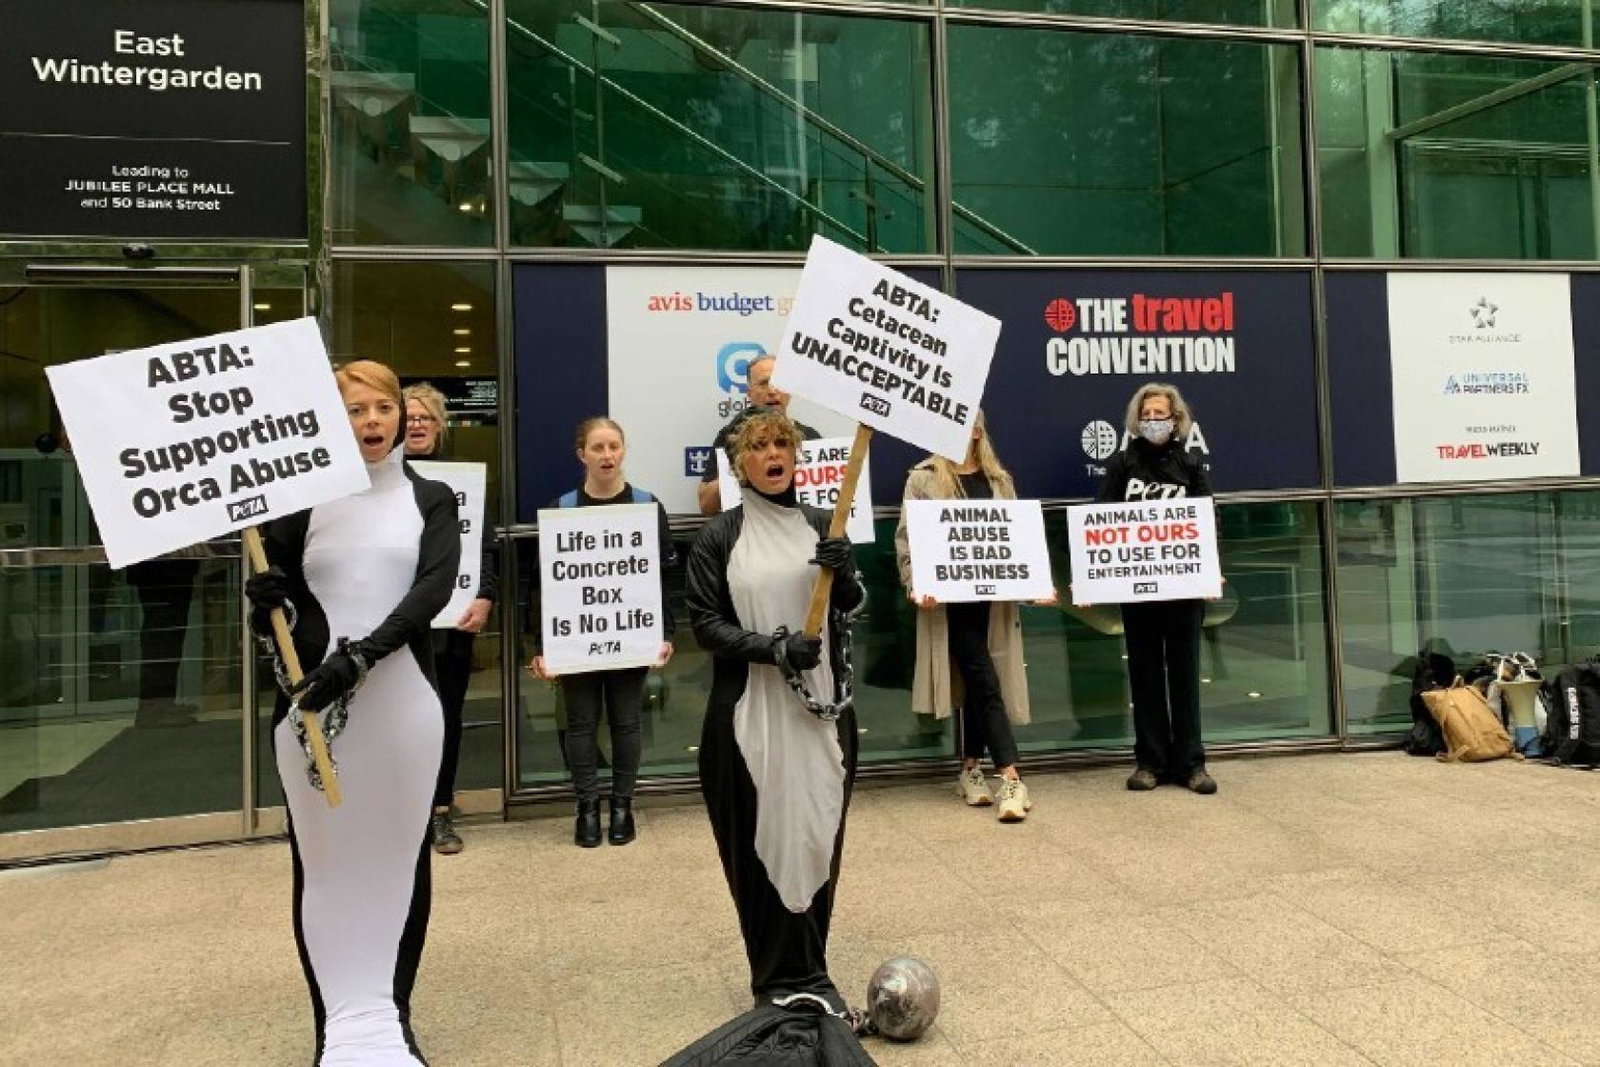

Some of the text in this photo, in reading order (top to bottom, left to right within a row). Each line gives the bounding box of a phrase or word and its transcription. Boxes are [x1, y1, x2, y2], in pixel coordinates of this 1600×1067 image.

[114, 30, 185, 56] East
[31, 57, 263, 91] Wintergarden
[111, 165, 189, 178] Leading to
[64, 180, 235, 195] JUBILEE PLACE MALL
[80, 197, 221, 211] and 50 Bank Street
[647, 292, 693, 311] avis
[697, 292, 775, 317] budget
[872, 278, 940, 323] ABTA:
[1076, 292, 1234, 333] THE travel
[848, 297, 947, 356] Cetacean
[827, 317, 953, 388] Captivity Is
[1046, 336, 1236, 375] CONVENTION
[148, 343, 254, 388] ABTA:
[791, 331, 970, 425] UNACCEPTABLE
[168, 386, 254, 423] Stop
[119, 409, 319, 478] Supporting
[818, 448, 848, 462] ARE
[132, 447, 331, 518] Orca Abuse
[940, 507, 1012, 523] ANIMAL
[1084, 505, 1197, 526] ANIMALS ARE
[556, 529, 643, 553] Life in a
[948, 527, 1010, 542] ABUSE
[1085, 523, 1199, 546] NOT OURS
[950, 545, 1012, 561] IS BAD
[1086, 543, 1200, 566] TO USE FOR
[552, 555, 649, 581] Concrete
[935, 565, 1030, 581] BUSINESS
[1088, 563, 1201, 580] ENTERTAINMENT
[582, 586, 623, 606] Box
[552, 608, 654, 637] Is No Life
